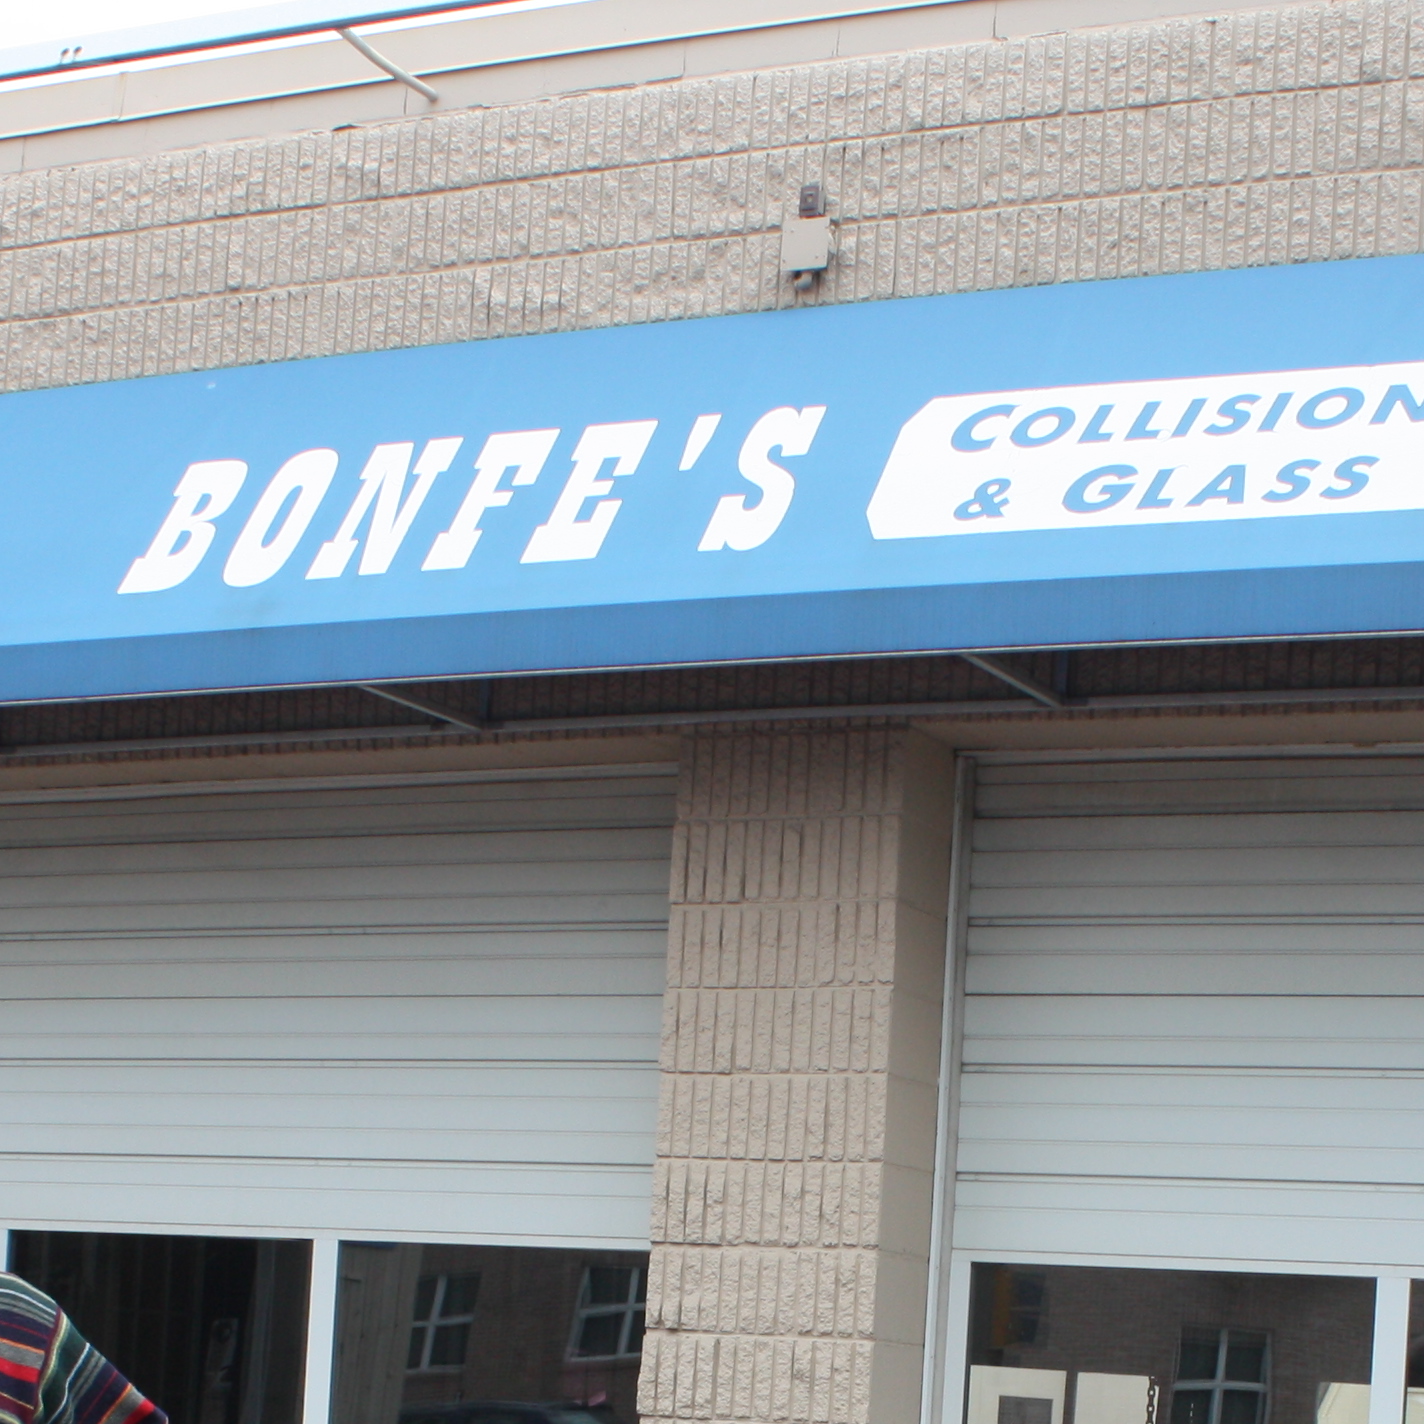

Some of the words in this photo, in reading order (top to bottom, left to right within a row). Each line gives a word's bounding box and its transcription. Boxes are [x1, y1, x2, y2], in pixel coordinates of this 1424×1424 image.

[117, 405, 827, 594] BONFE'S
[953, 478, 1012, 521] &
[1061, 455, 1380, 514] GLASS
